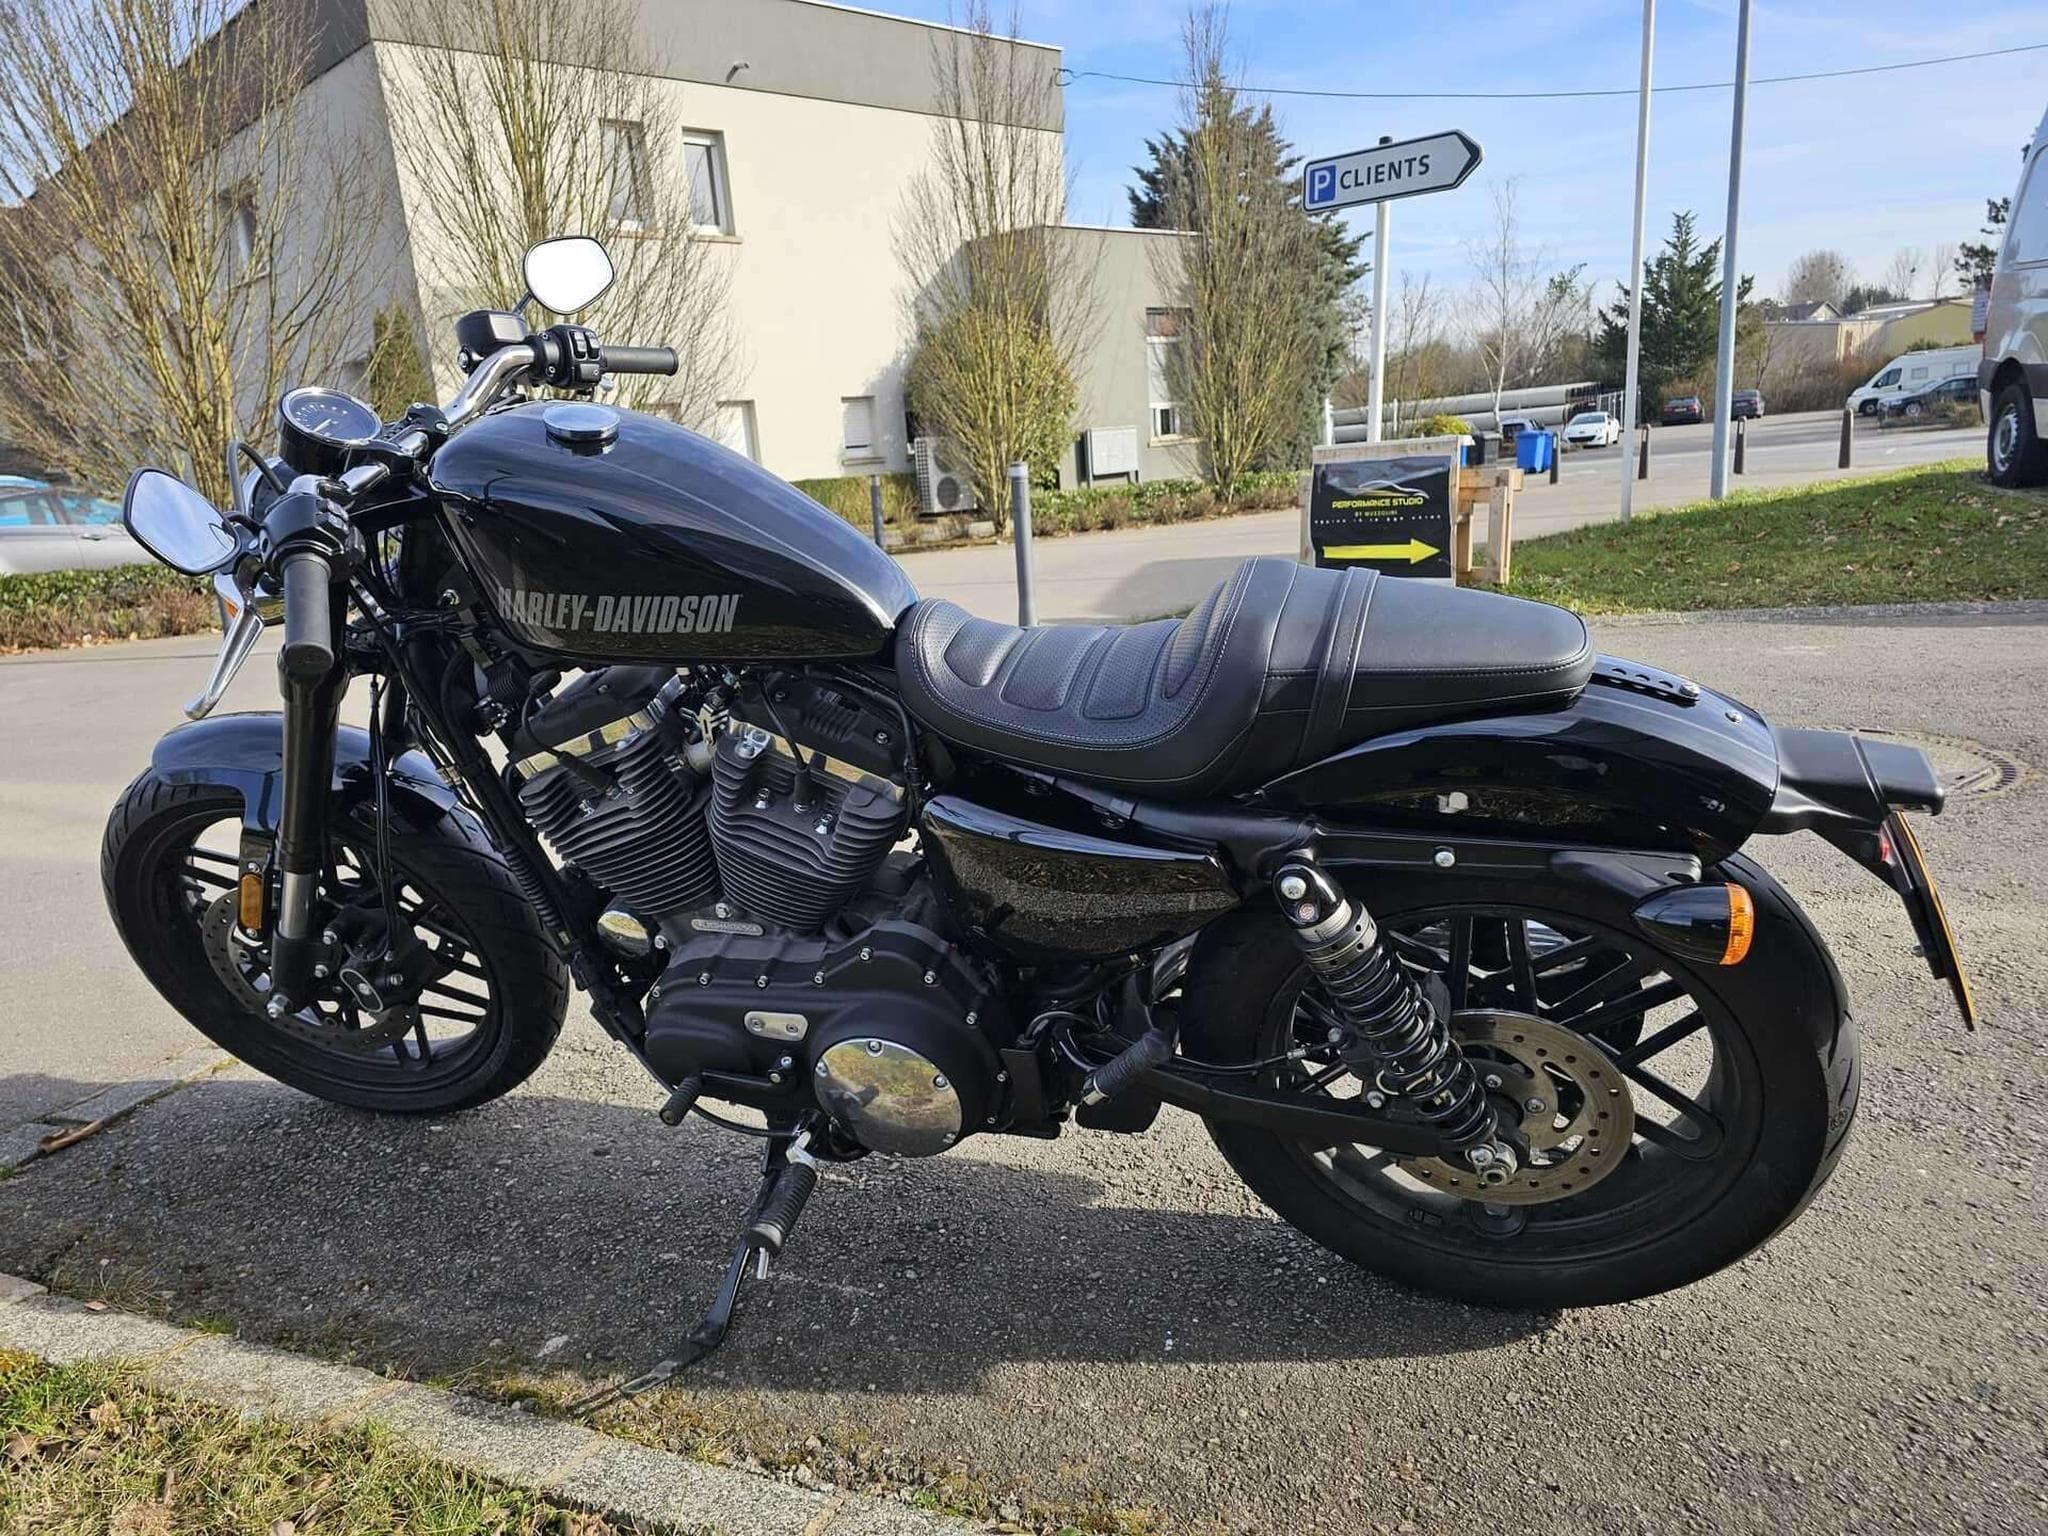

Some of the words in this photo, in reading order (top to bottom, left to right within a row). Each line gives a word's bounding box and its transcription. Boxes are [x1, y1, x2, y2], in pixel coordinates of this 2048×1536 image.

[1314, 170, 1330, 201] P
[1340, 154, 1430, 189] CLIENTS
[1332, 498, 1391, 508] PERFORMANCE
[1392, 496, 1424, 506] STUDIO
[499, 587, 740, 634] HARLEY-DAVIDSON
